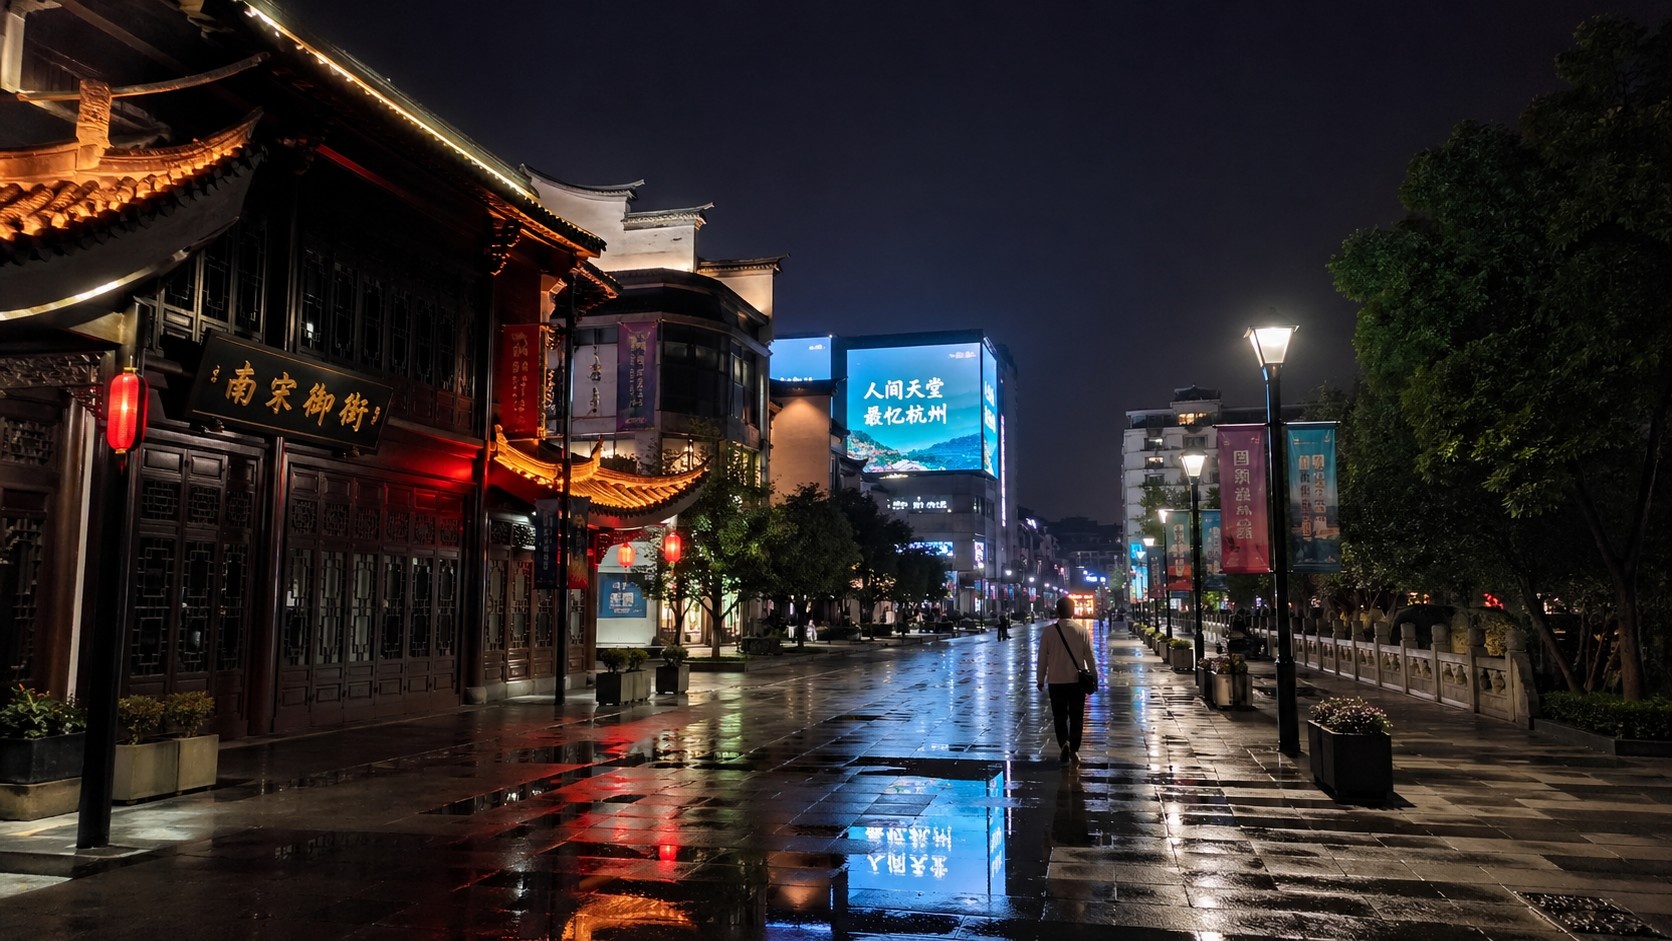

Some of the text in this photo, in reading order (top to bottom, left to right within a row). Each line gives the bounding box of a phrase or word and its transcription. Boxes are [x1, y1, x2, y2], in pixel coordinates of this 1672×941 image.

[225, 359, 370, 433] 南宋御街
[863, 376, 945, 400] 人间天堂
[863, 403, 947, 427] 最忆杭州
